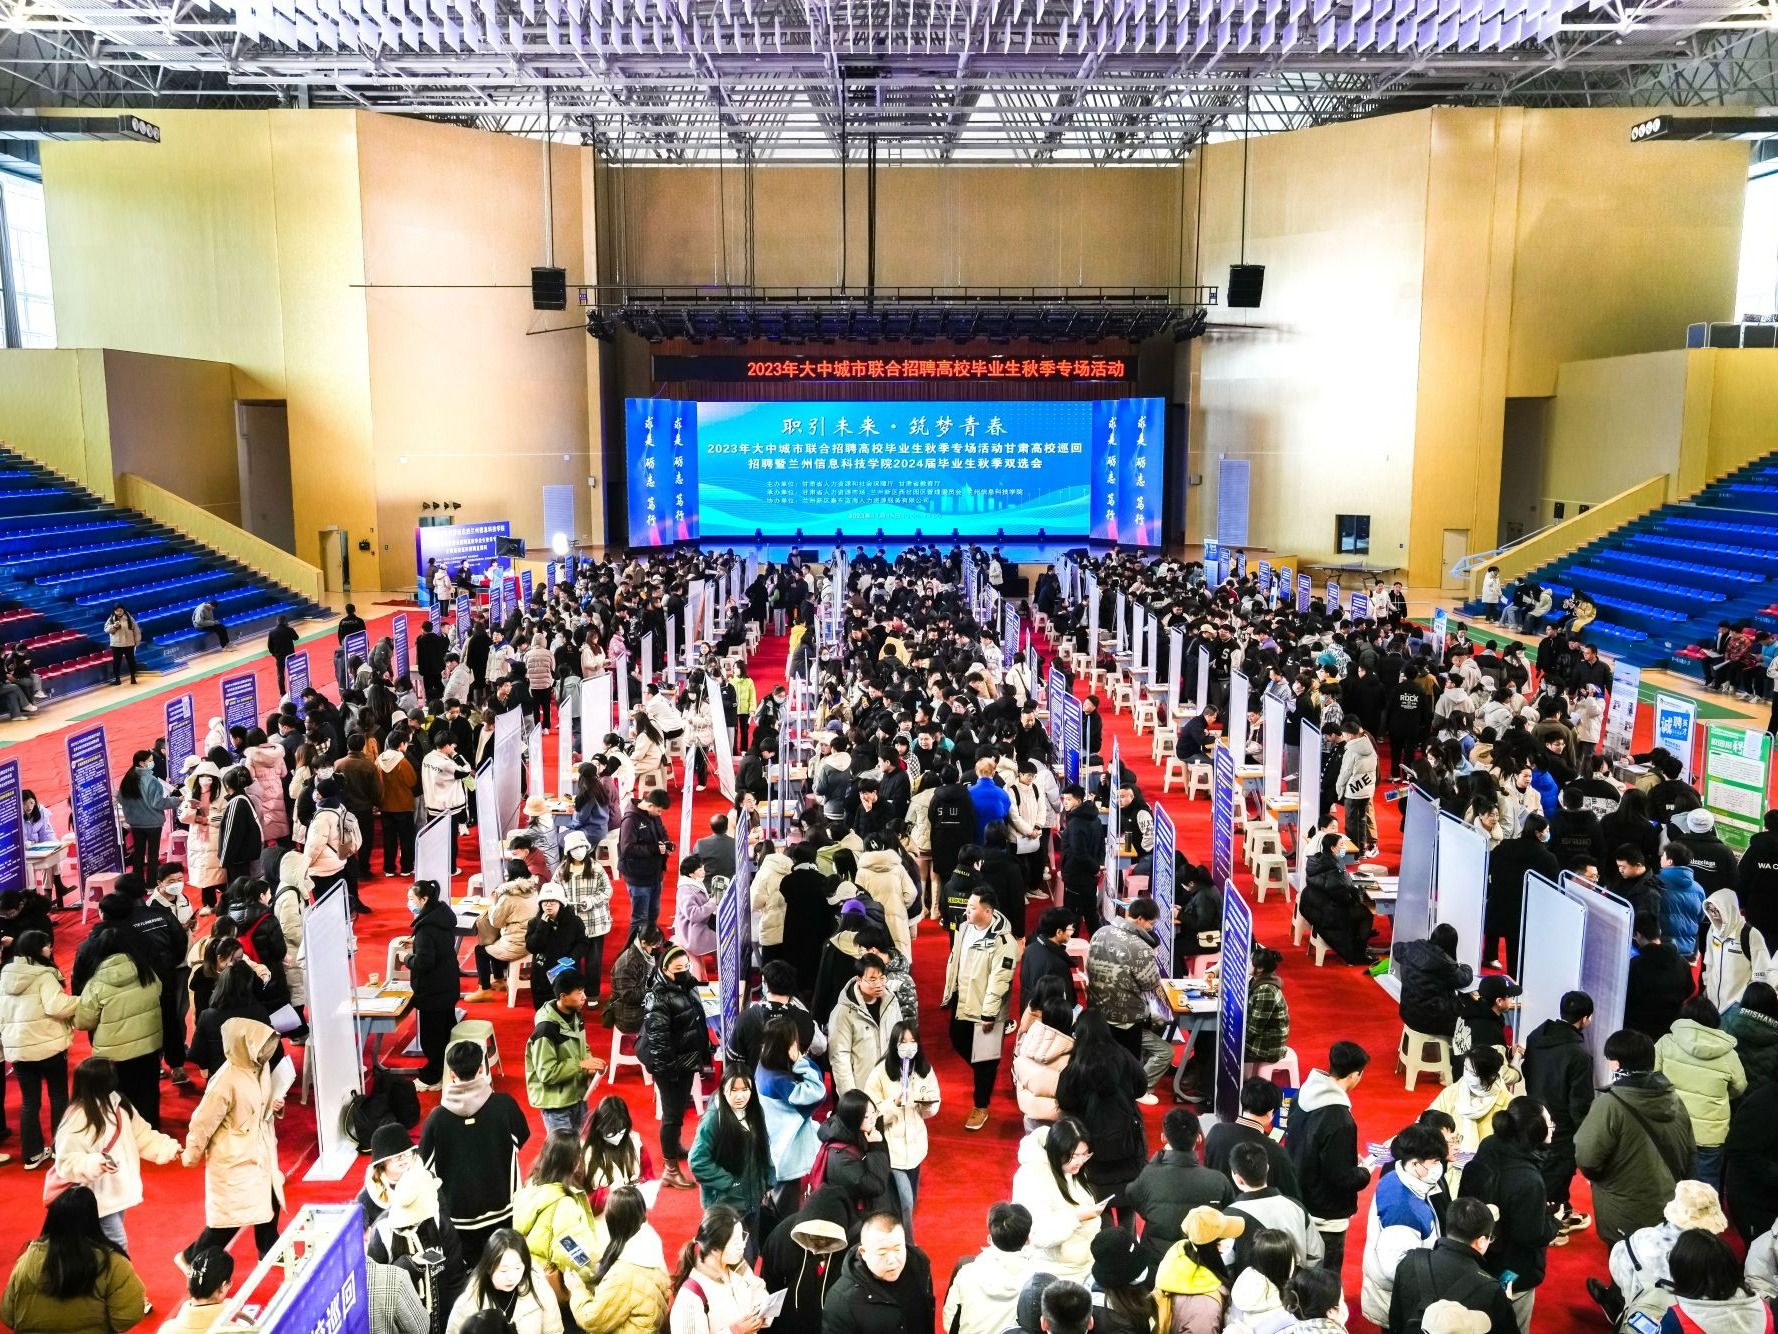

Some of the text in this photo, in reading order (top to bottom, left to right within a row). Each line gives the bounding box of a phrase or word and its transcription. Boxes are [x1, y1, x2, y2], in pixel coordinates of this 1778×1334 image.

[747, 359, 1125, 379] 2023年大中城市联合招聘高校毕业生秋季专场活动
[707, 442, 1083, 455] 2023年大中城市联合招聘高校毕业生秋季专场活动甘肃高校巡回
[748, 457, 1043, 470] 招聘暨兰州信息科技学院2024届毕业生秋季双选会
[1399, 694, 1419, 703] ROCK
[1349, 773, 1372, 794] ME
